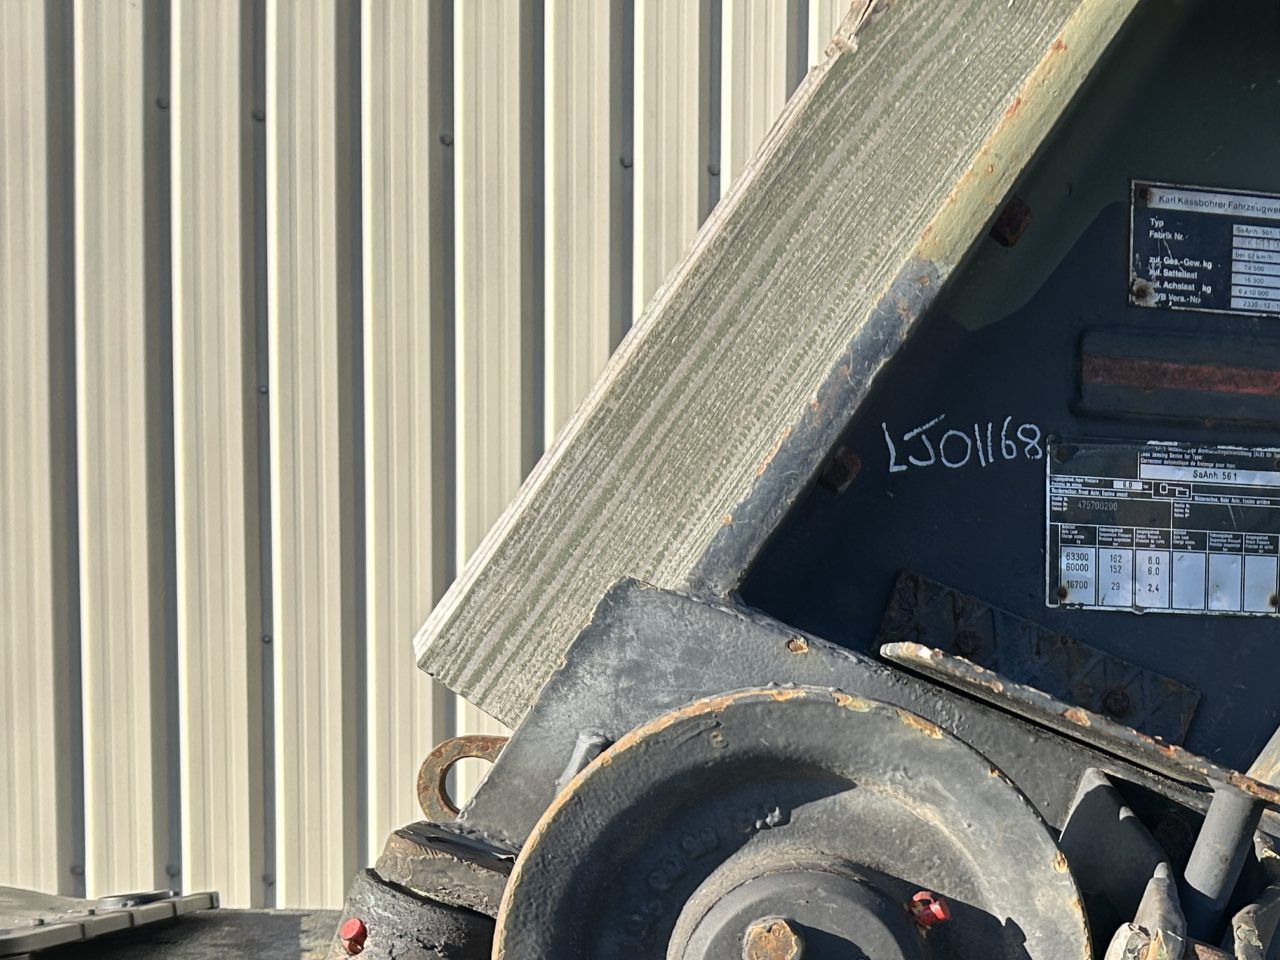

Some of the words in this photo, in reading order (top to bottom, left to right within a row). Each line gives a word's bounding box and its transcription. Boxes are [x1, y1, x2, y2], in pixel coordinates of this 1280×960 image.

[1158, 194, 1176, 204] Karl
[1149, 217, 1165, 228] Typ
[1149, 230, 1173, 240] Fabrik
[1202, 260, 1213, 270] kg
[1202, 284, 1212, 294] kg
[1192, 470, 1218, 480] SaAnh
[1065, 552, 1089, 562] 63300
[1065, 563, 1089, 572] 60000
[1110, 565, 1122, 574] 152
[1147, 567, 1160, 576] 6.0
[1111, 582, 1120, 591] 29
[1147, 583, 1160, 593] 2.4
